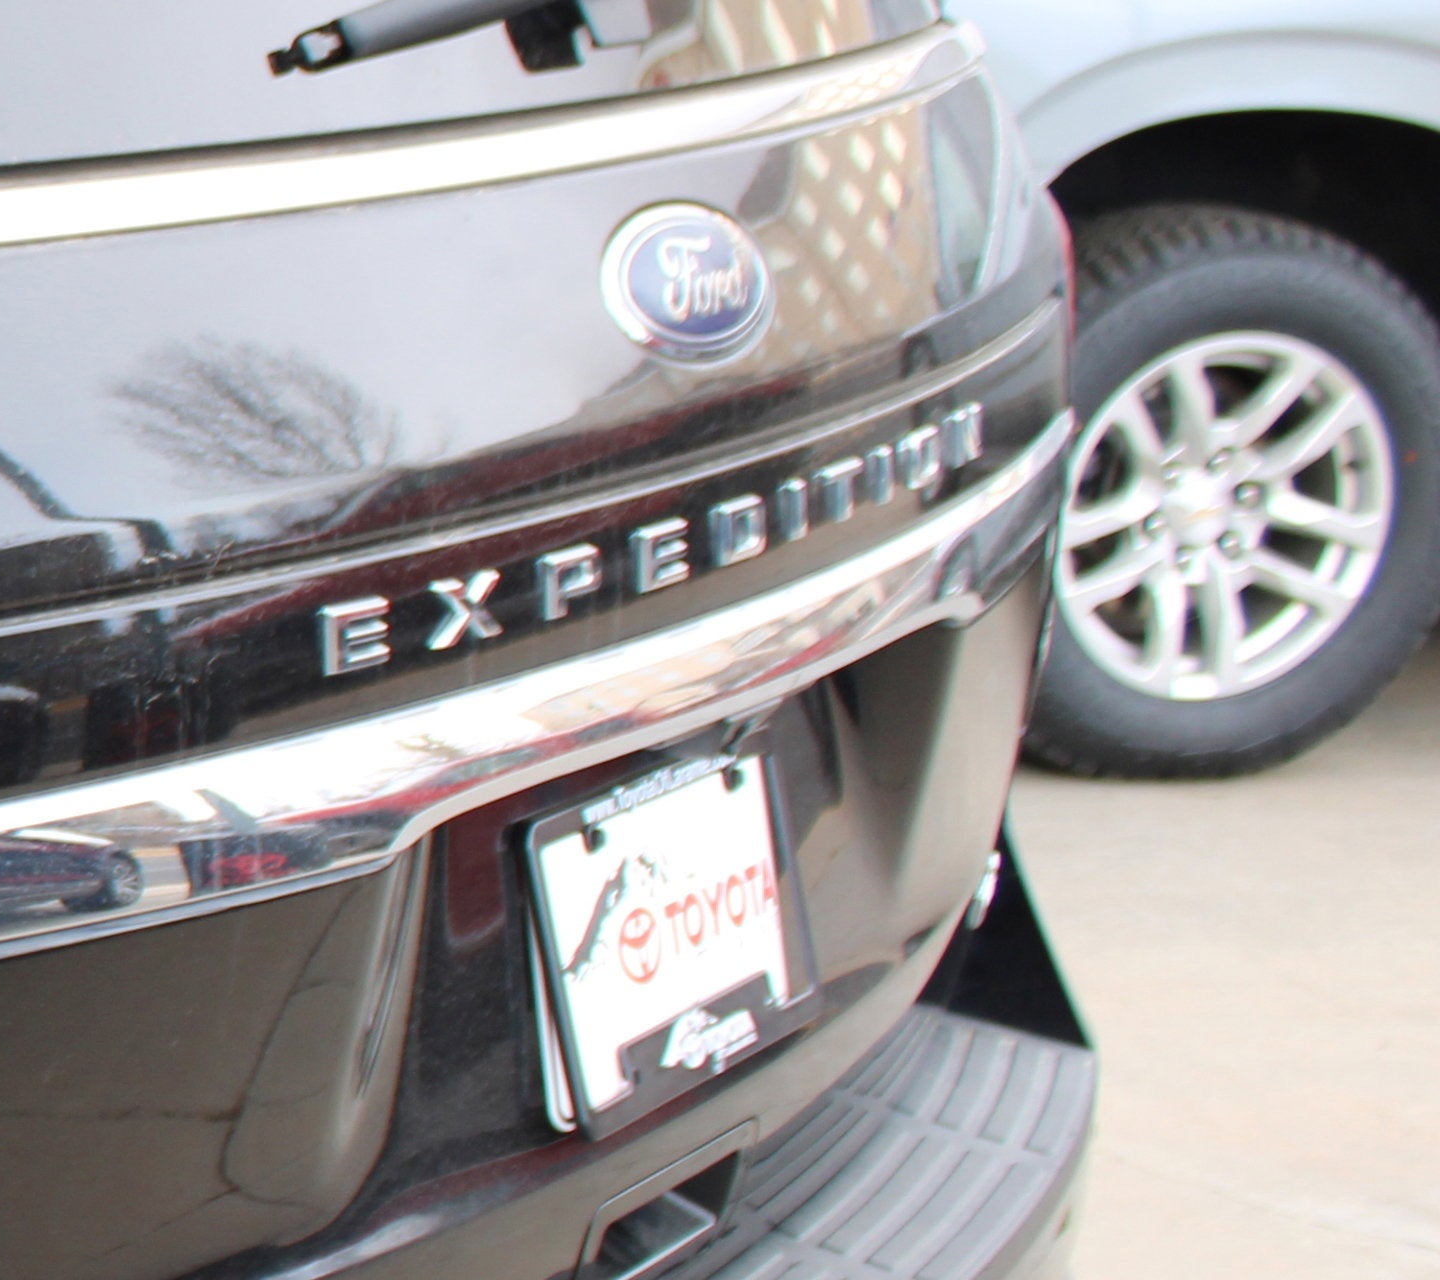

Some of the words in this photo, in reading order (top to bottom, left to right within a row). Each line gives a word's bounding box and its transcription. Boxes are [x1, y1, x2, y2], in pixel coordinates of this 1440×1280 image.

[658, 236, 749, 324] Ford
[316, 401, 986, 677] EXPEDITION
[664, 858, 778, 955] TOYOTA
